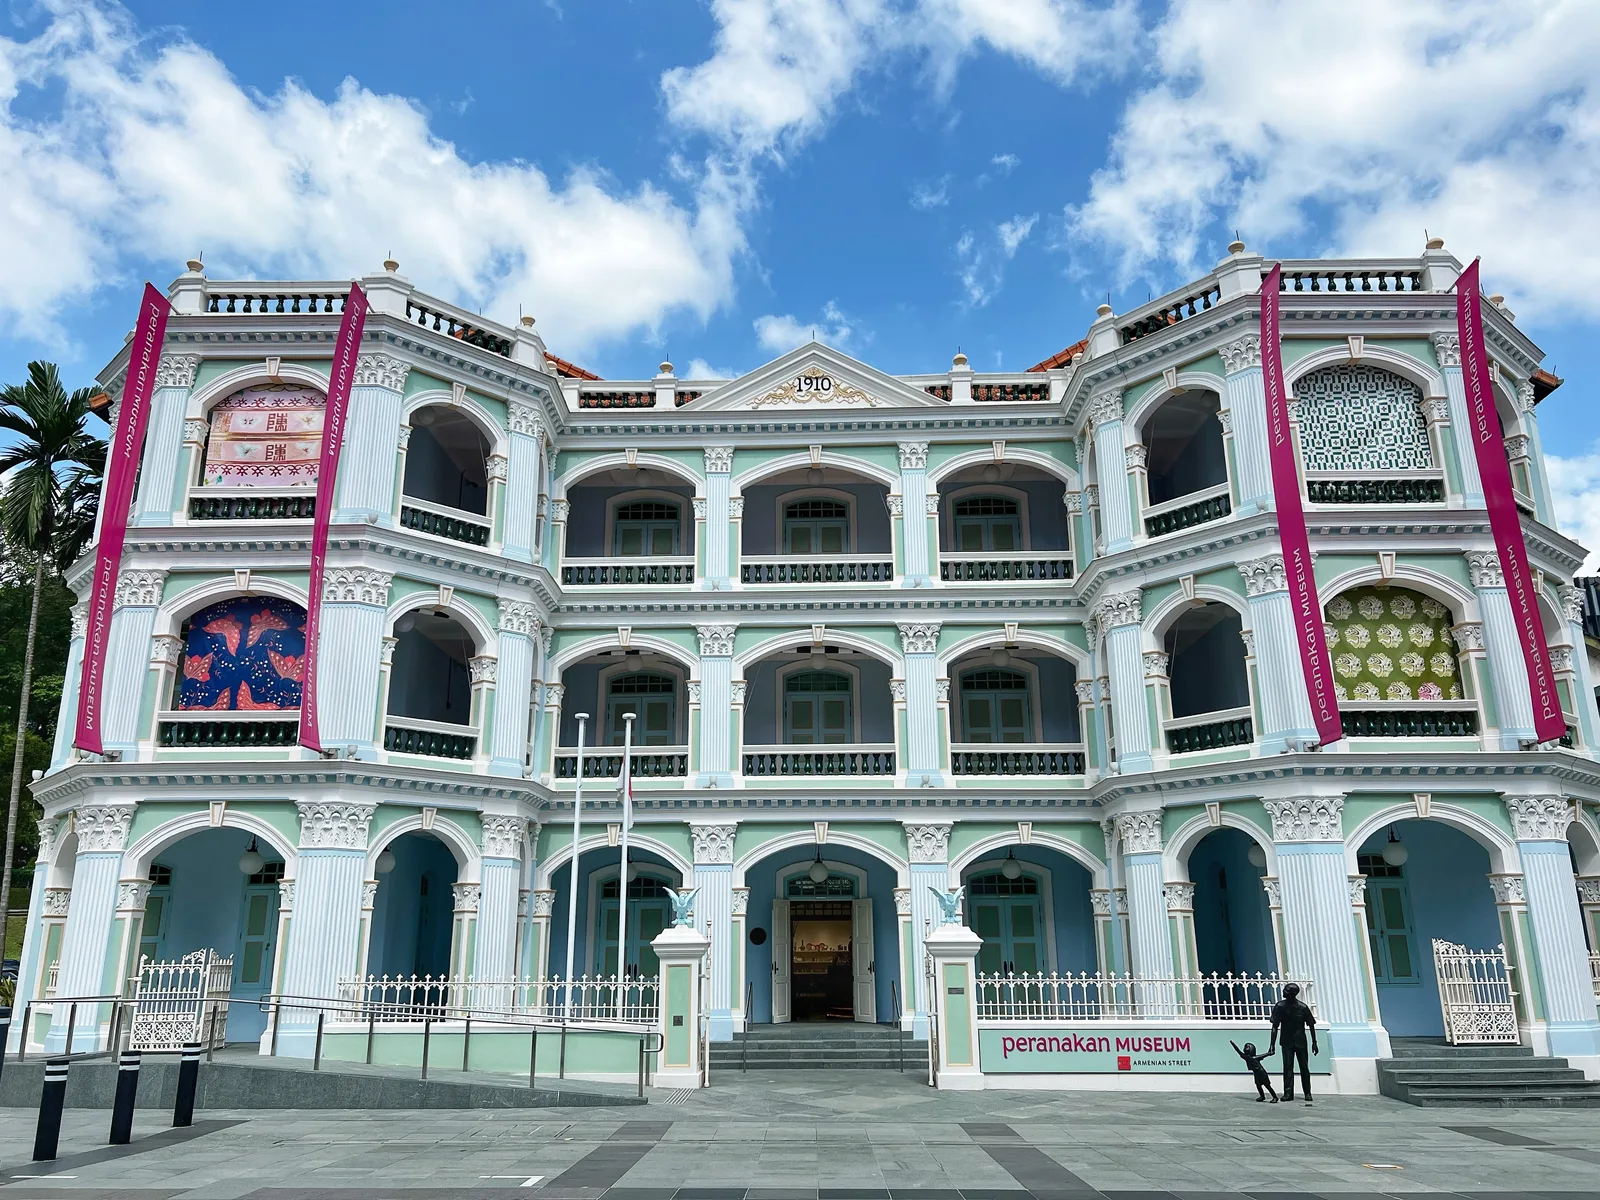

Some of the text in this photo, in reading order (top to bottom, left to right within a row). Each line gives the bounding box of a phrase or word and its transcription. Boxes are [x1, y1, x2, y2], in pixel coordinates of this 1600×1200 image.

[124, 302, 160, 458] peranakan MUSEUM
[328, 301, 360, 456] peranakan MUSEUM
[796, 377, 831, 392] 1910
[1265, 291, 1286, 447] peranakan MUSEUM
[1463, 287, 1493, 443] peranakan MUSEUM
[86, 556, 112, 730] peranakan MUSEUM
[1293, 548, 1332, 722] peranakan MUSEUM
[1507, 545, 1556, 720] peranakan MUSEUM
[1002, 1033, 1190, 1058] peranakan MUSEUM
